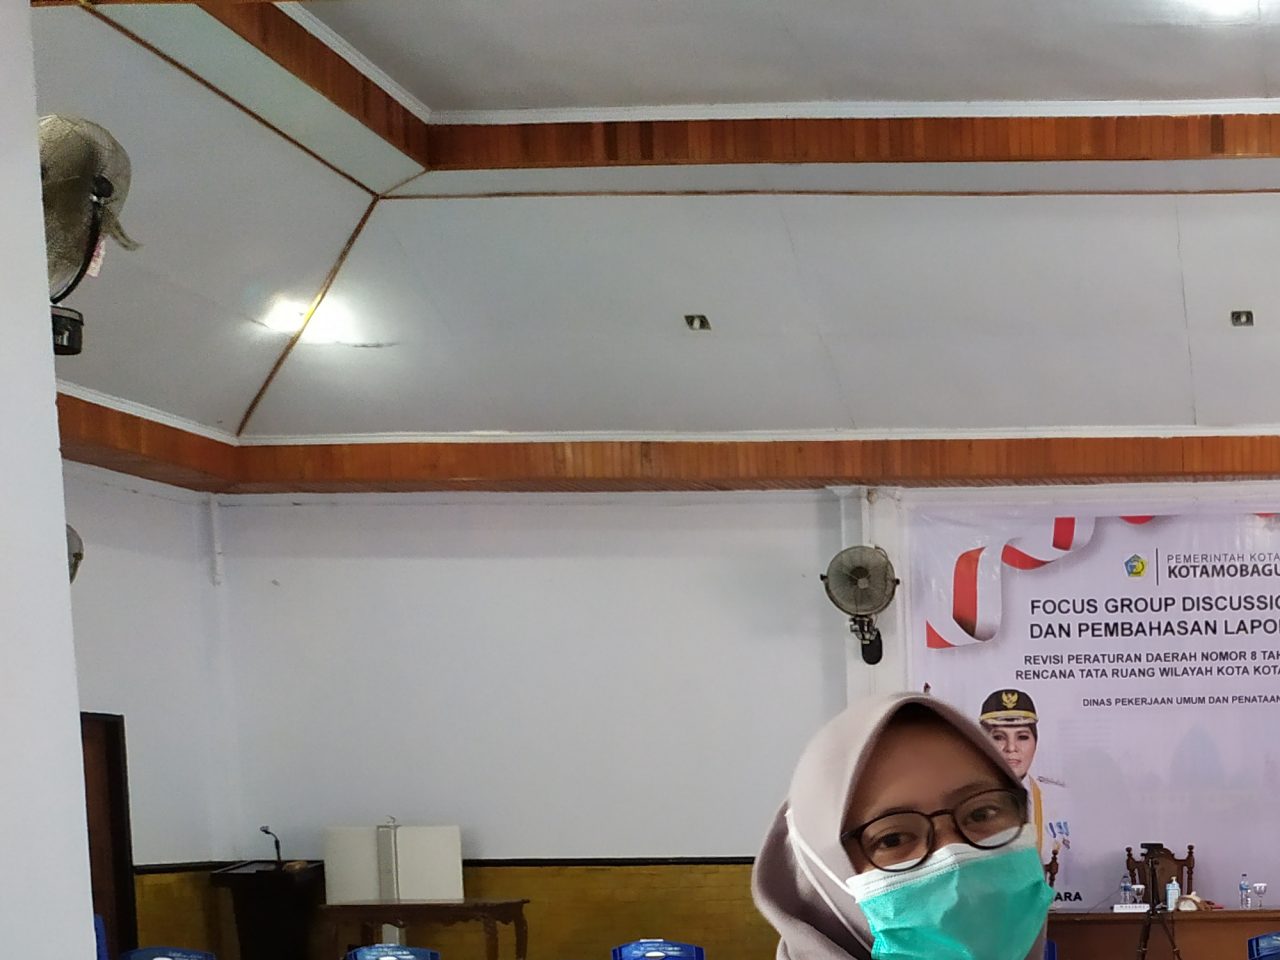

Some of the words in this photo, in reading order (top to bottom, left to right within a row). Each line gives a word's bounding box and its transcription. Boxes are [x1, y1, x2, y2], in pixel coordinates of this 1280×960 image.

[1167, 553, 1245, 564] PEMERINTAH
[1249, 552, 1280, 562] KOTA
[1030, 599, 1098, 615] FOCUS
[1104, 597, 1176, 614] GROUP
[1029, 623, 1071, 639] DAN
[1078, 620, 1217, 638] PEMBAHASAN
[1024, 654, 1064, 665] REVISI
[1067, 653, 1142, 665] PERATURAN
[1145, 652, 1197, 663] DAERAH
[1201, 651, 1247, 662] NOMOR
[1250, 650, 1257, 661] 8
[1015, 669, 1076, 680] RENCANA
[1079, 668, 1109, 680] TATA
[1111, 667, 1156, 679] RUANG
[1158, 666, 1213, 678] WILAYAH
[1217, 665, 1250, 677] KOTA
[1082, 698, 1112, 707] DINAS
[1114, 697, 1174, 706] PEKERJAAN
[1175, 696, 1206, 705] UMUM
[1208, 695, 1229, 705] DAN
[1054, 891, 1083, 902] ARA
